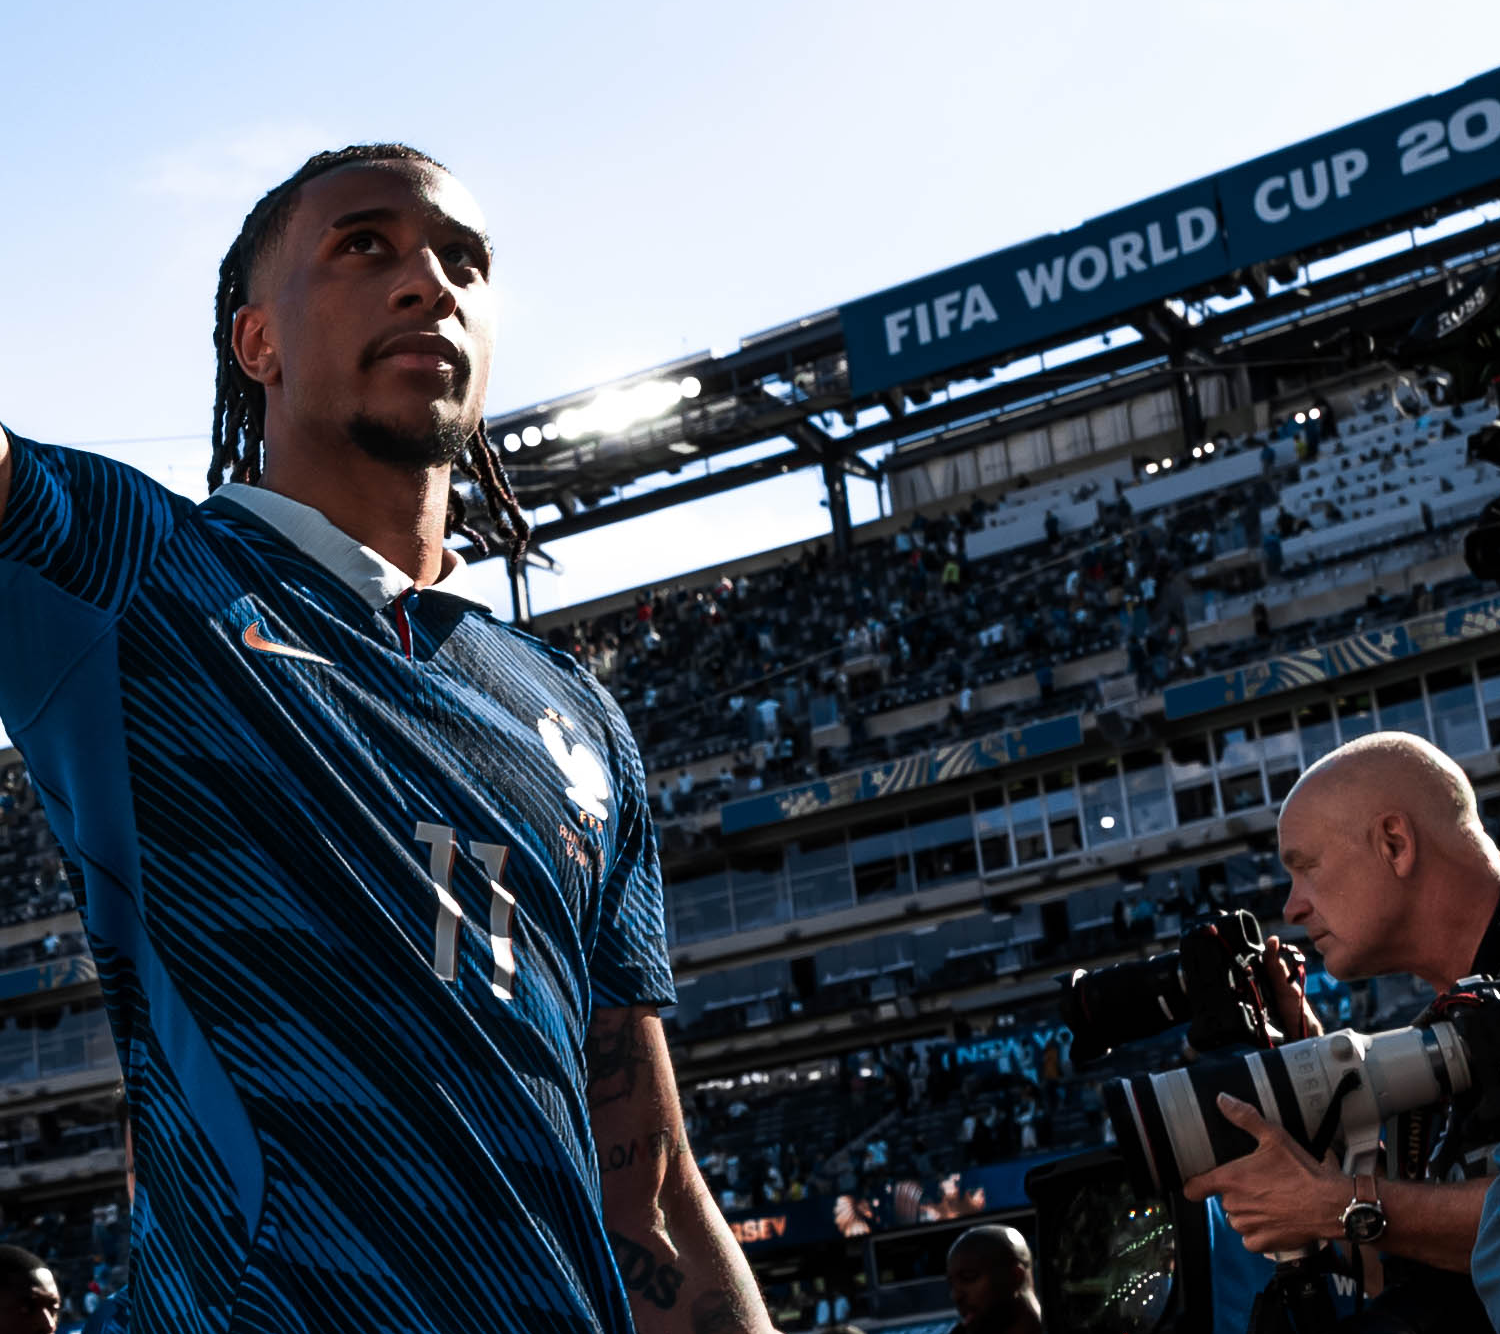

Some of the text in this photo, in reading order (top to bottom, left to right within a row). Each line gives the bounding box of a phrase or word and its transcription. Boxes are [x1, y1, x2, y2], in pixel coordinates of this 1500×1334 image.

[883, 288, 999, 357] FIFA
[1016, 206, 1219, 310] WORLD
[1252, 149, 1371, 227] CUP
[415, 821, 517, 1001] 11
